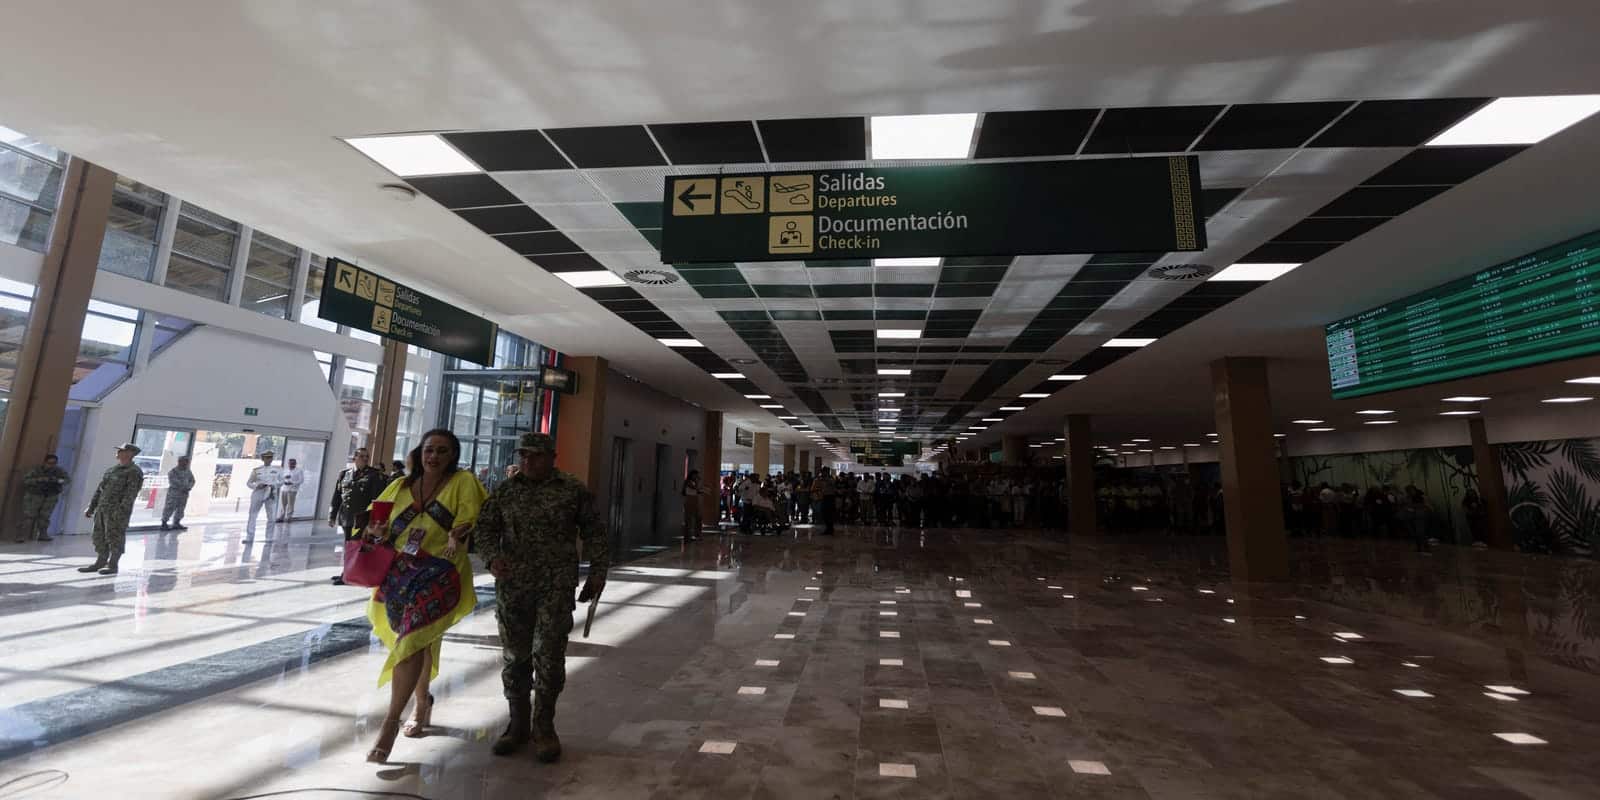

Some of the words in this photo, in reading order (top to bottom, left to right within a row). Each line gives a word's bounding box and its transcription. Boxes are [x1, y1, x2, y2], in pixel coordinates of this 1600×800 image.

[819, 173, 885, 192] Salidas
[818, 195, 897, 211] Departures
[818, 211, 968, 233] Documentación
[818, 235, 880, 249] Check-in
[396, 286, 420, 305] Salidas
[1358, 306, 1388, 321] FLIGHTS
[392, 311, 440, 337] Documentación
